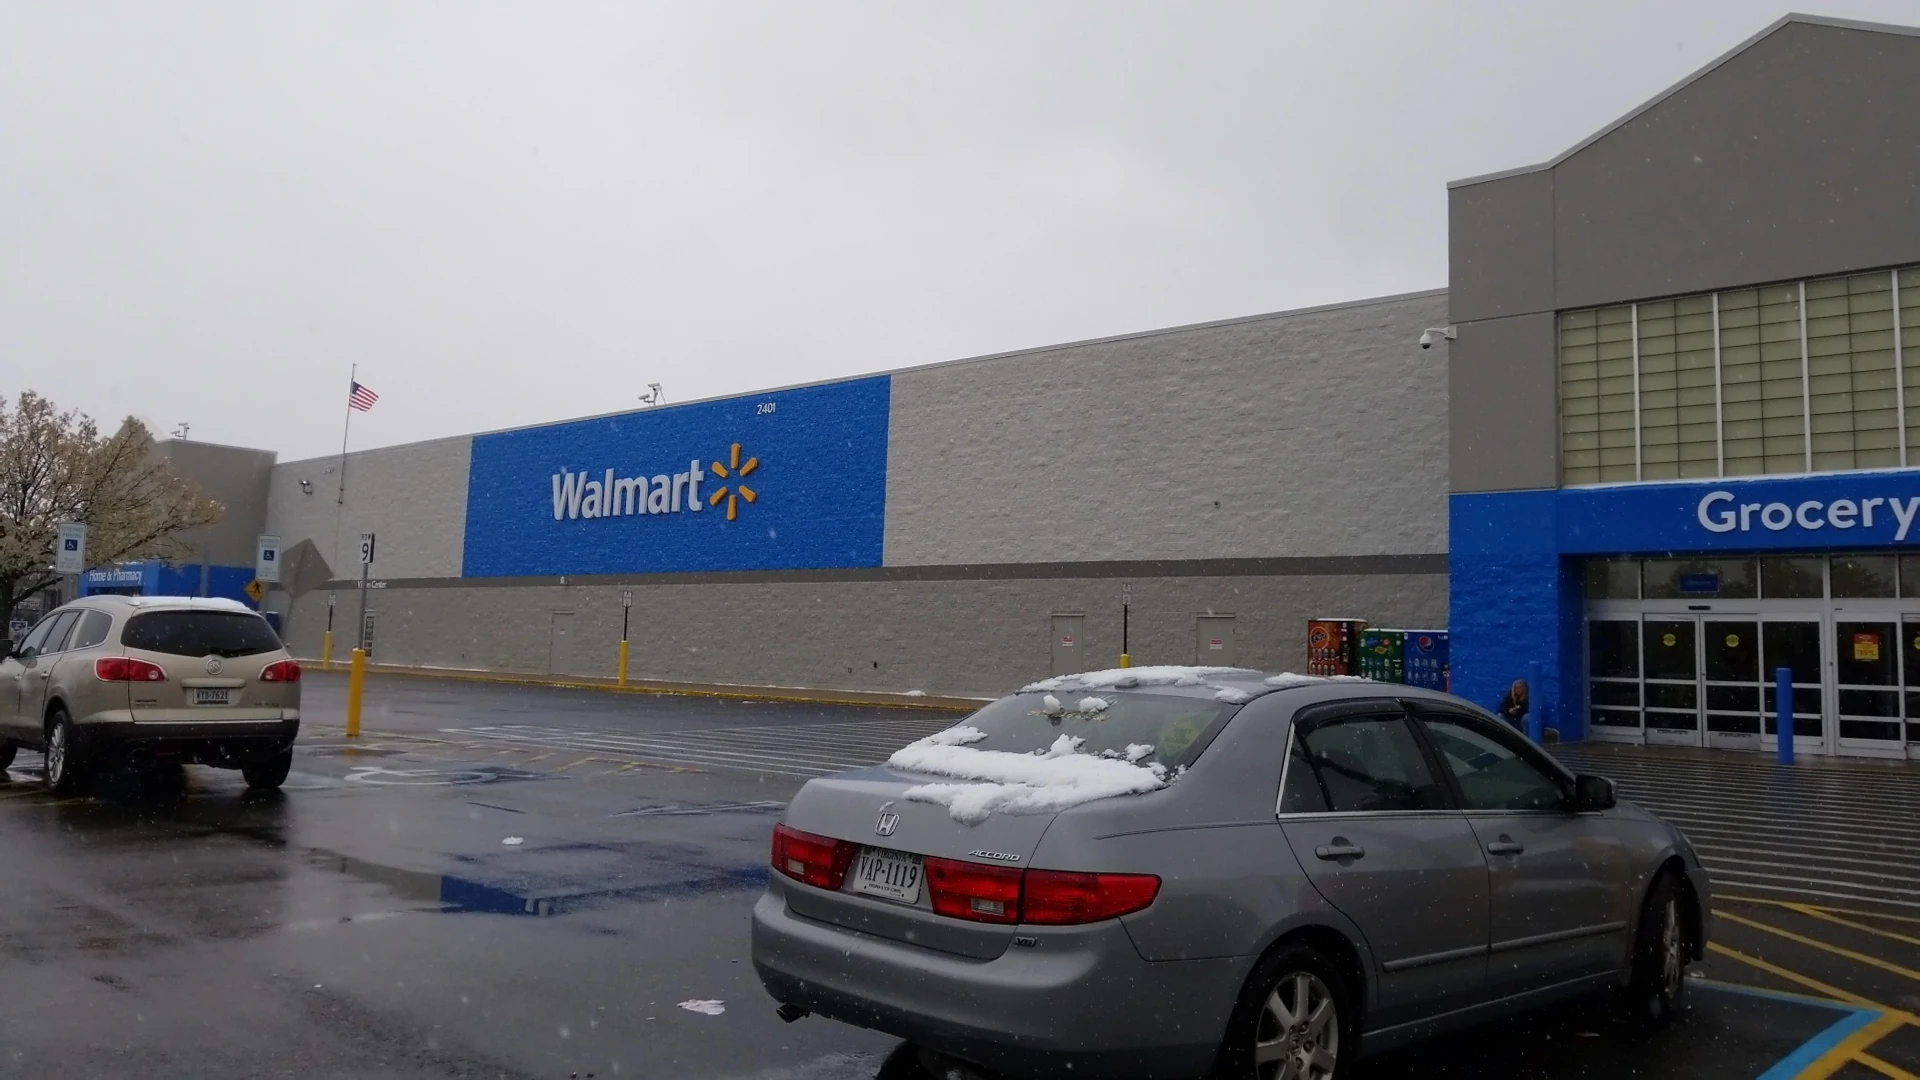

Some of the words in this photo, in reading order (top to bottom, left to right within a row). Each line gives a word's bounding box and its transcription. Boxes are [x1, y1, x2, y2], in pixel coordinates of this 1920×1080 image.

[757, 402, 776, 415] 2401
[552, 459, 705, 521] Walmart
[1697, 490, 1920, 541] Grocery
[361, 542, 369, 561] 9
[89, 569, 106, 582] Home
[107, 571, 112, 582] &
[113, 568, 143, 585] Pharmacy
[371, 580, 387, 589] Center
[876, 848, 907, 863] VIRGINIA
[968, 849, 1021, 862] ACCORD
